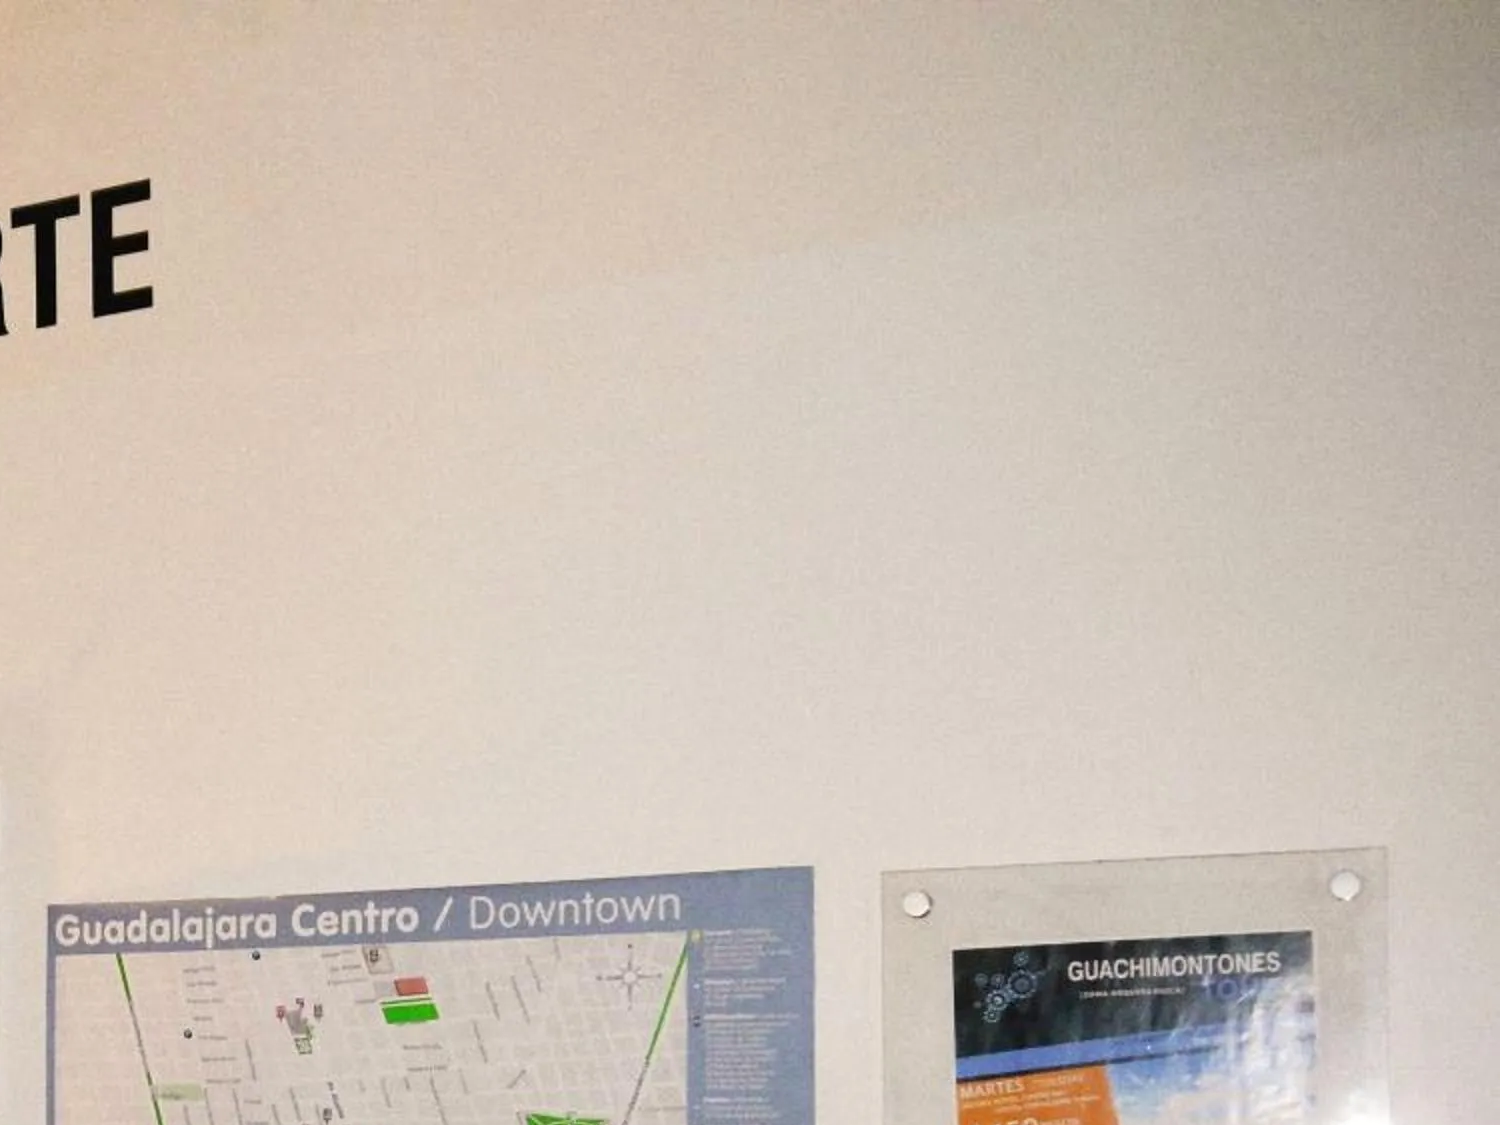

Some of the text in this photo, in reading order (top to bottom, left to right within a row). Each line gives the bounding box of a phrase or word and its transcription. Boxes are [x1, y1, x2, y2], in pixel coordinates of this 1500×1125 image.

[55, 907, 277, 949] Guadalajara
[291, 901, 419, 938] Centro
[470, 892, 681, 930] Downtown
[1068, 951, 1282, 981] GUACHIMONTONES
[960, 1080, 1025, 1098] MARTES
